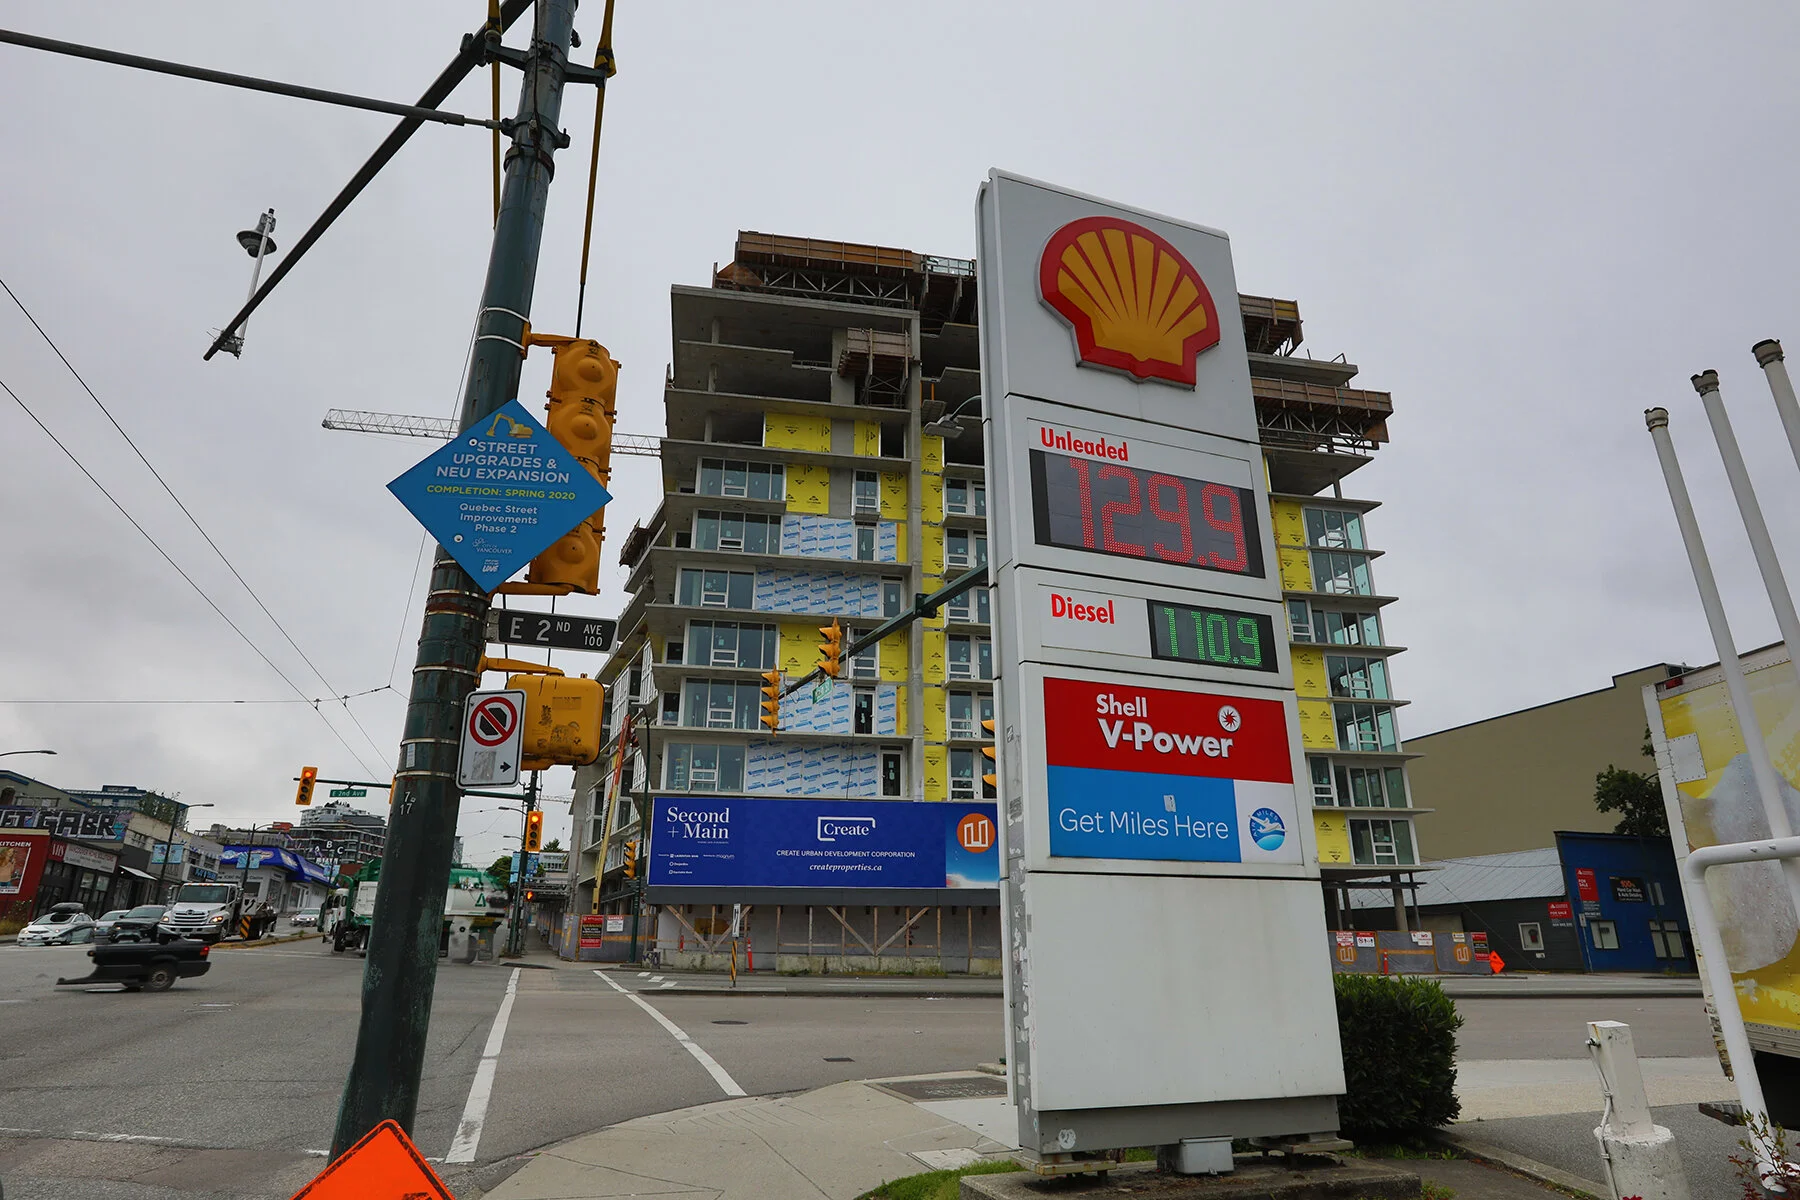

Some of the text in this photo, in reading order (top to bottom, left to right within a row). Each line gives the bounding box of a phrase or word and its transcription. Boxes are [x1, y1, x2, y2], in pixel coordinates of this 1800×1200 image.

[477, 442, 538, 454] STREET
[1040, 427, 1128, 462] Unleaded
[453, 454, 557, 469] UPGRADES &
[436, 466, 570, 484] NEU EXPANSION
[426, 485, 576, 500] COMPLETION: SPRING 2020
[460, 503, 537, 514] Quebec Street
[1069, 457, 1248, 572] 129.9
[460, 514, 538, 525] Improvements
[475, 524, 517, 534] Phase 2
[1051, 594, 1115, 624] Diesel
[510, 617, 524, 639] E
[583, 624, 602, 635] AVE
[584, 636, 603, 646] 100
[1164, 608, 1262, 666] 110.9
[1096, 694, 1148, 717] Shell
[1097, 718, 1234, 758] V-Power
[400, 803, 412, 815] 17
[667, 806, 730, 823] Second
[1256, 810, 1278, 821] MILES
[668, 823, 729, 839] + Main
[824, 822, 869, 836] Create
[1059, 808, 1229, 840] Get Miles Here
[809, 863, 882, 873] createproperties.ca
